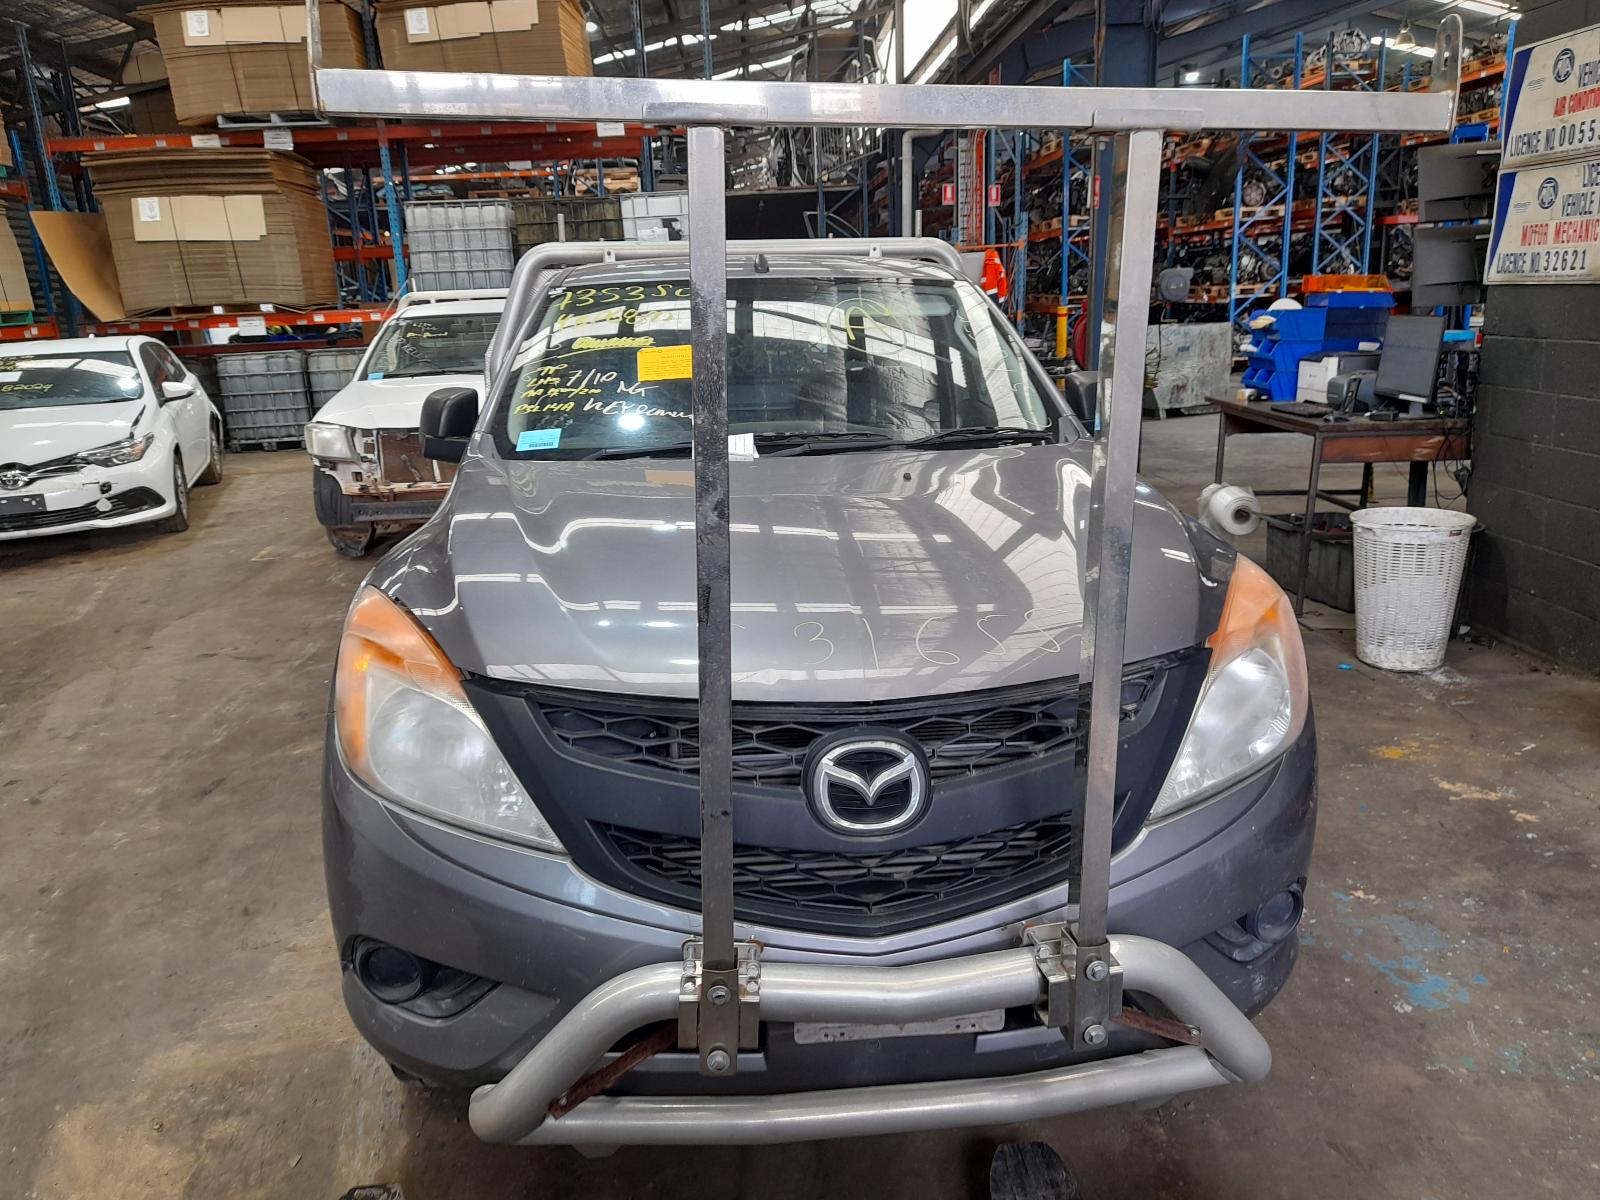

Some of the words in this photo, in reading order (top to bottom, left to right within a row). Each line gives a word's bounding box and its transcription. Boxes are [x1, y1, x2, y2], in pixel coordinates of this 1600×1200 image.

[1553, 95, 1567, 118] AIR
[1509, 130, 1541, 157] LICENCE
[1561, 191, 1596, 217] VEHICLE
[1520, 223, 1549, 246] MOTOR
[1552, 218, 1600, 245] MECHANIC
[1496, 252, 1527, 274] LICENCE
[1543, 249, 1588, 271] 32621
